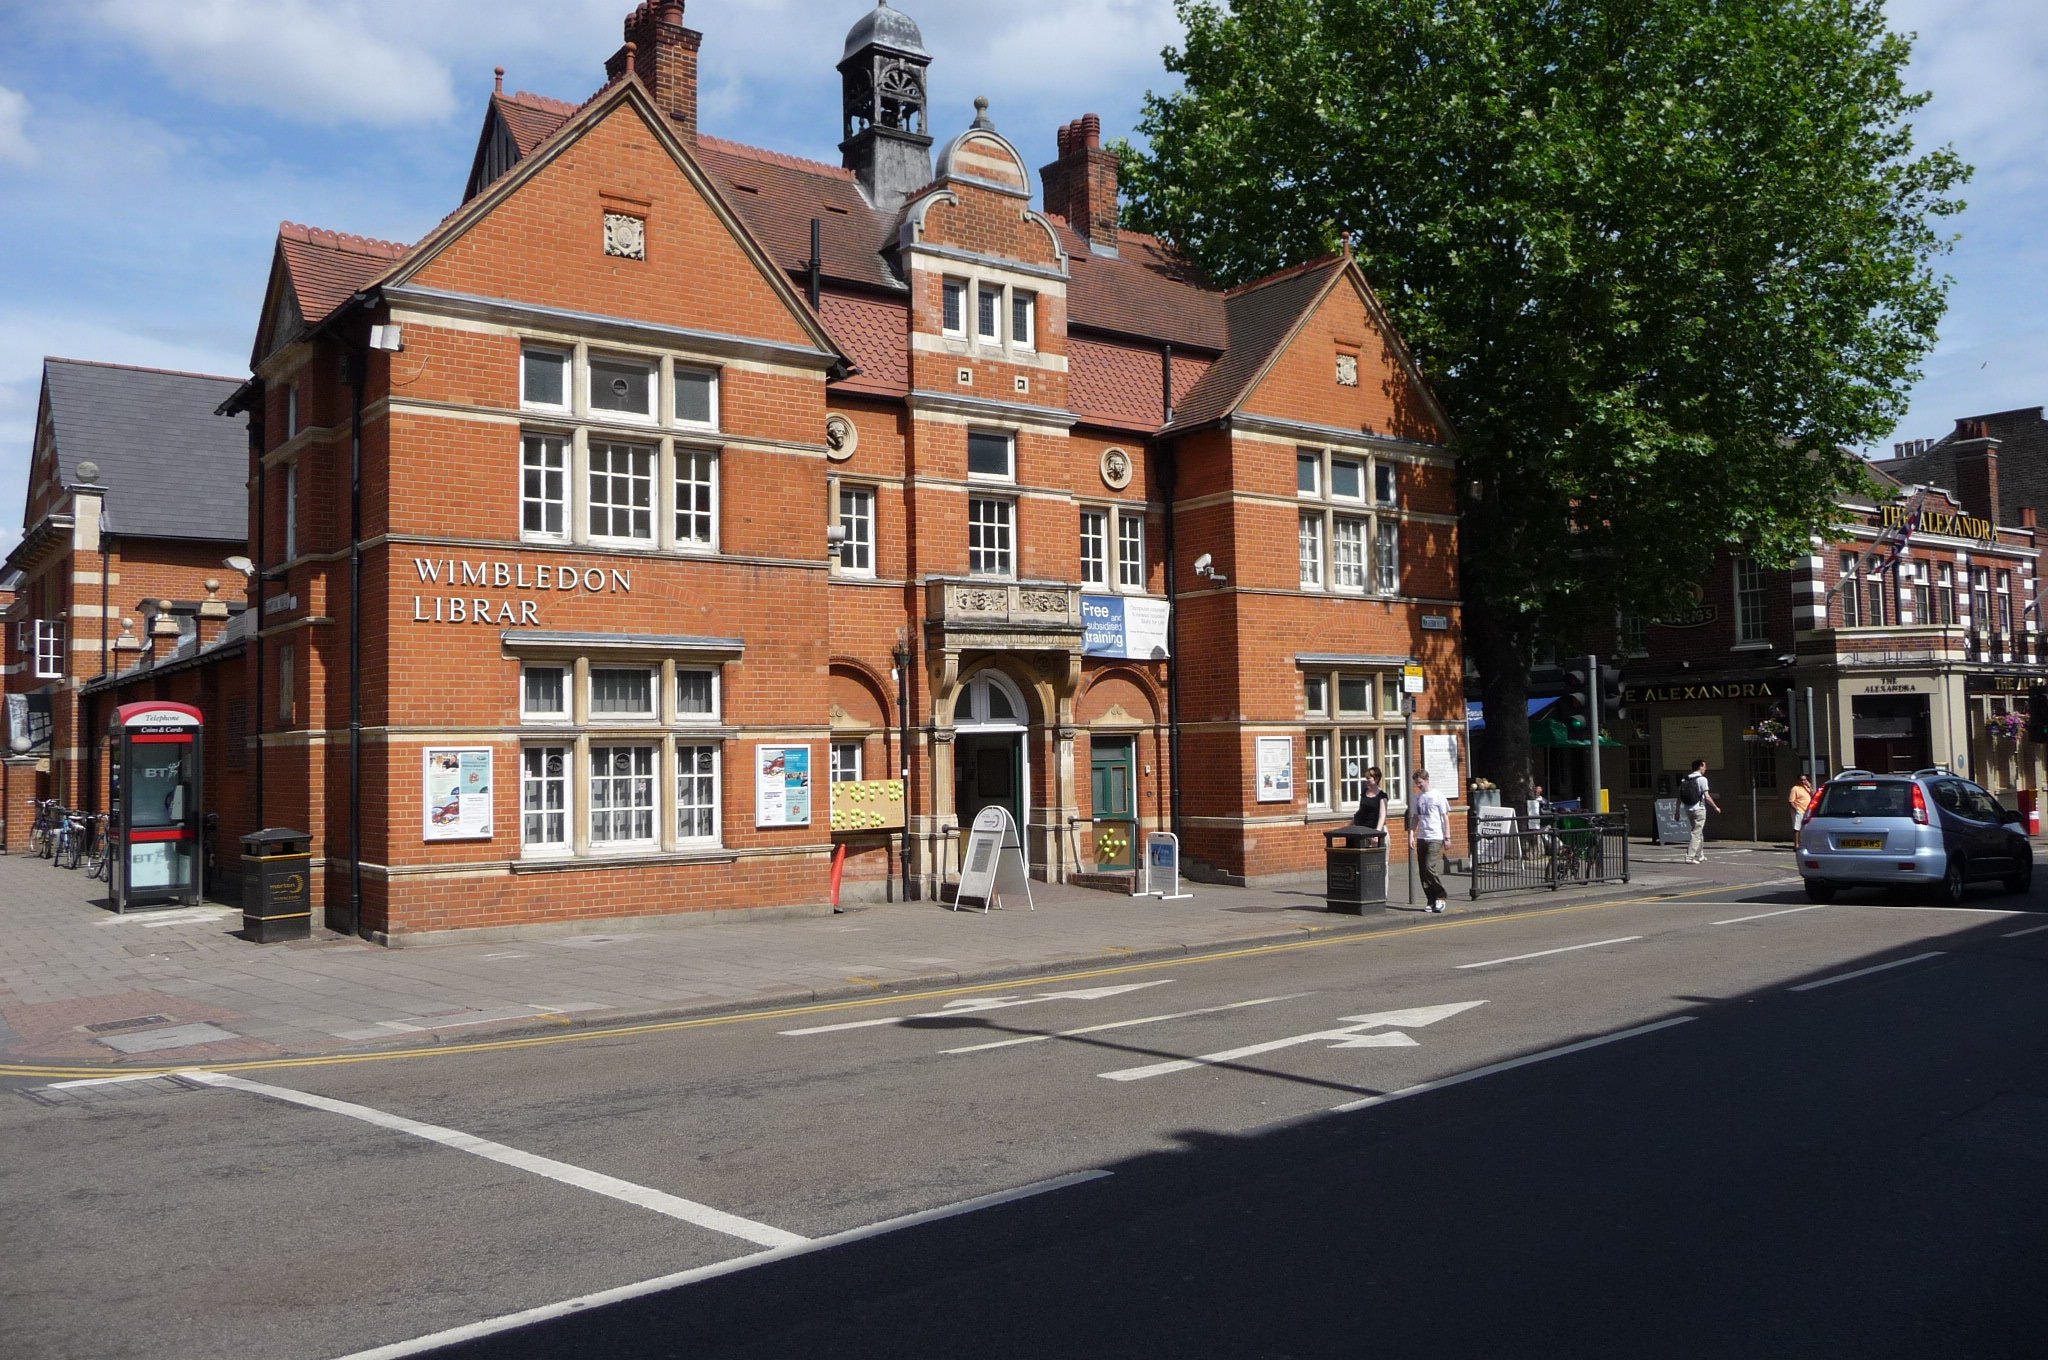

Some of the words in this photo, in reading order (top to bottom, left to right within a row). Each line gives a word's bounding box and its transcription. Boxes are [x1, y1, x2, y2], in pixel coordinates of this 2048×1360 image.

[1919, 511, 1999, 541] ALEXANDRA
[414, 558, 632, 593] WIMBLEDON
[413, 595, 540, 625] LIBRAR
[1082, 602, 1109, 617] Free
[1087, 621, 1122, 631] subsidised
[1085, 630, 1123, 647] training
[1881, 677, 1897, 686] THE
[1994, 677, 2015, 691] THE
[1645, 682, 1772, 702] ALEXANDRA
[1864, 684, 1916, 694] ALEXANDRA
[145, 714, 180, 722] Telephone
[145, 768, 168, 778] BT
